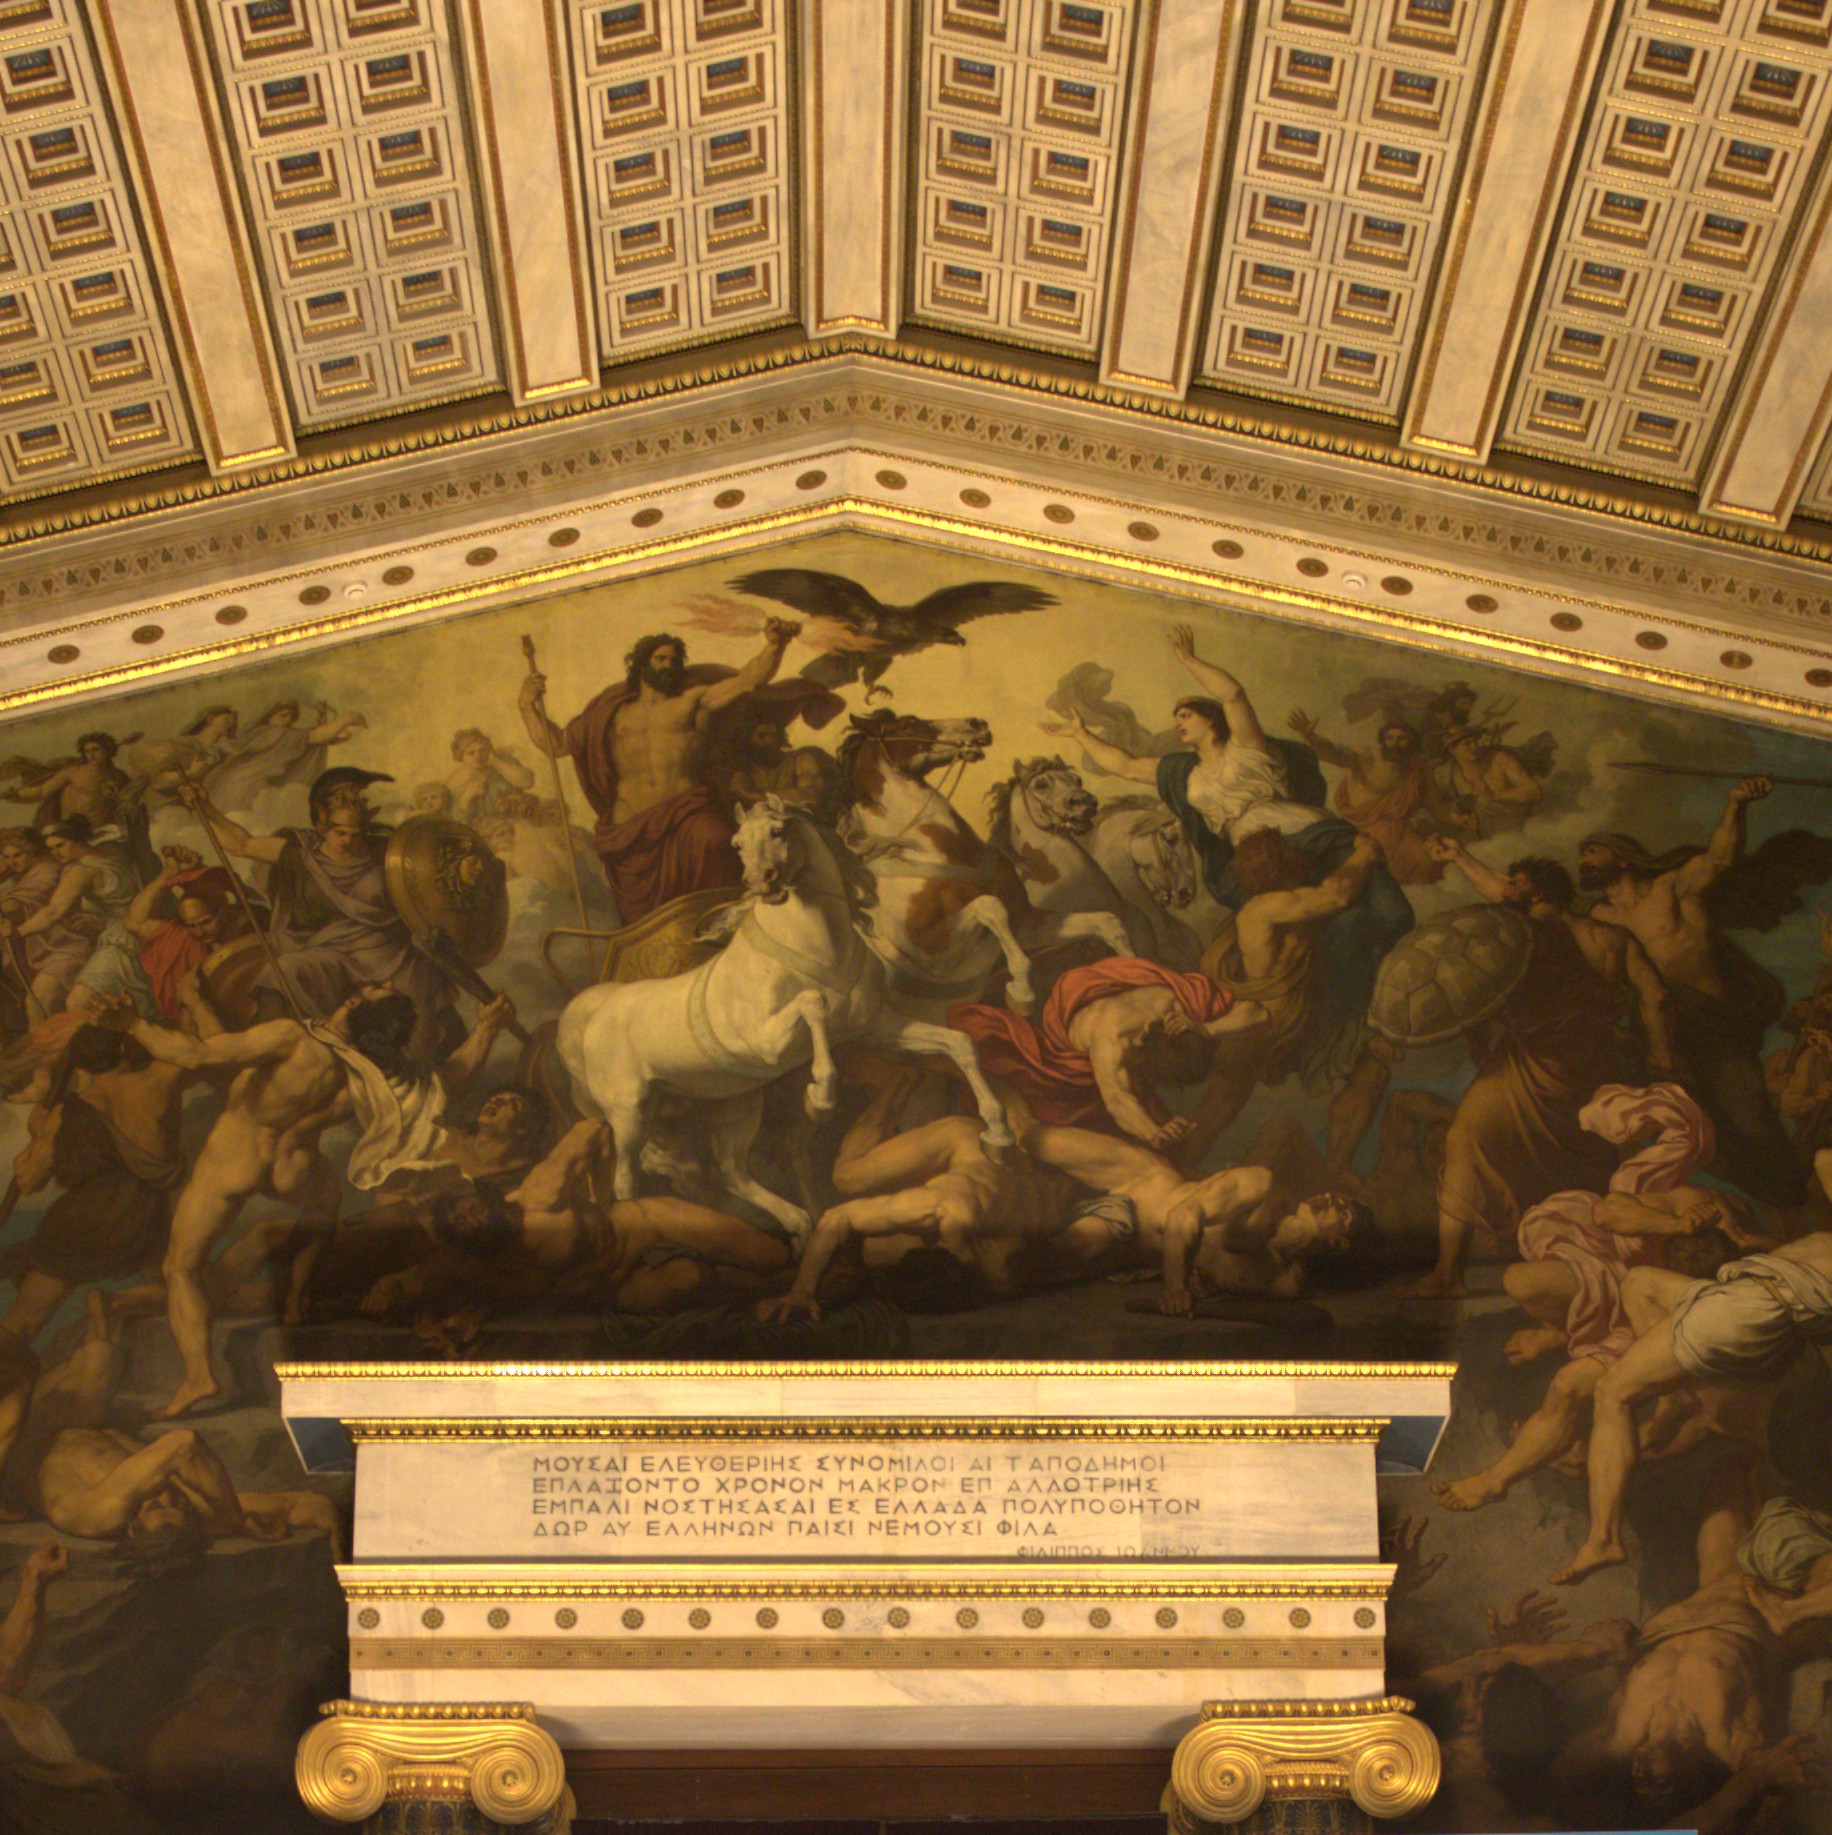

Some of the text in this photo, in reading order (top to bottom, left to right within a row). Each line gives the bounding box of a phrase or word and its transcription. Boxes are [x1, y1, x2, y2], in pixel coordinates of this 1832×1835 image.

[533, 1454, 628, 1473] ΜΟΥΣΑΙ
[641, 1455, 801, 1473] ΕΛΕΥΘΕΡΙΗΣ
[816, 1455, 954, 1472] ΣΥΝΟΜΙΛΟΙ
[715, 1477, 823, 1494] ΧΡΟΝΟΝ
[839, 1475, 947, 1493] ΜΑΚΡΟΝ
[960, 1477, 991, 1493] ΕΠ
[1007, 1476, 1158, 1495] ΑΛΛΟΤΡΙΗΣ
[532, 1496, 1200, 1516] ΕΜΠΑΛΙ ΝΟΣΤΗΣΑΣΑΙ ΕΣ ΕΛΛΑΔΑ ΠΟΛΥΠΟΘΗΤΟΝ
[533, 1519, 1058, 1537] ΔΩΡ ΑΥ ΕΛΛΗΝΩΝ ΠΑΙΣΙ ΝΕΜΟΥΣΙ ΦΙΛΑ
